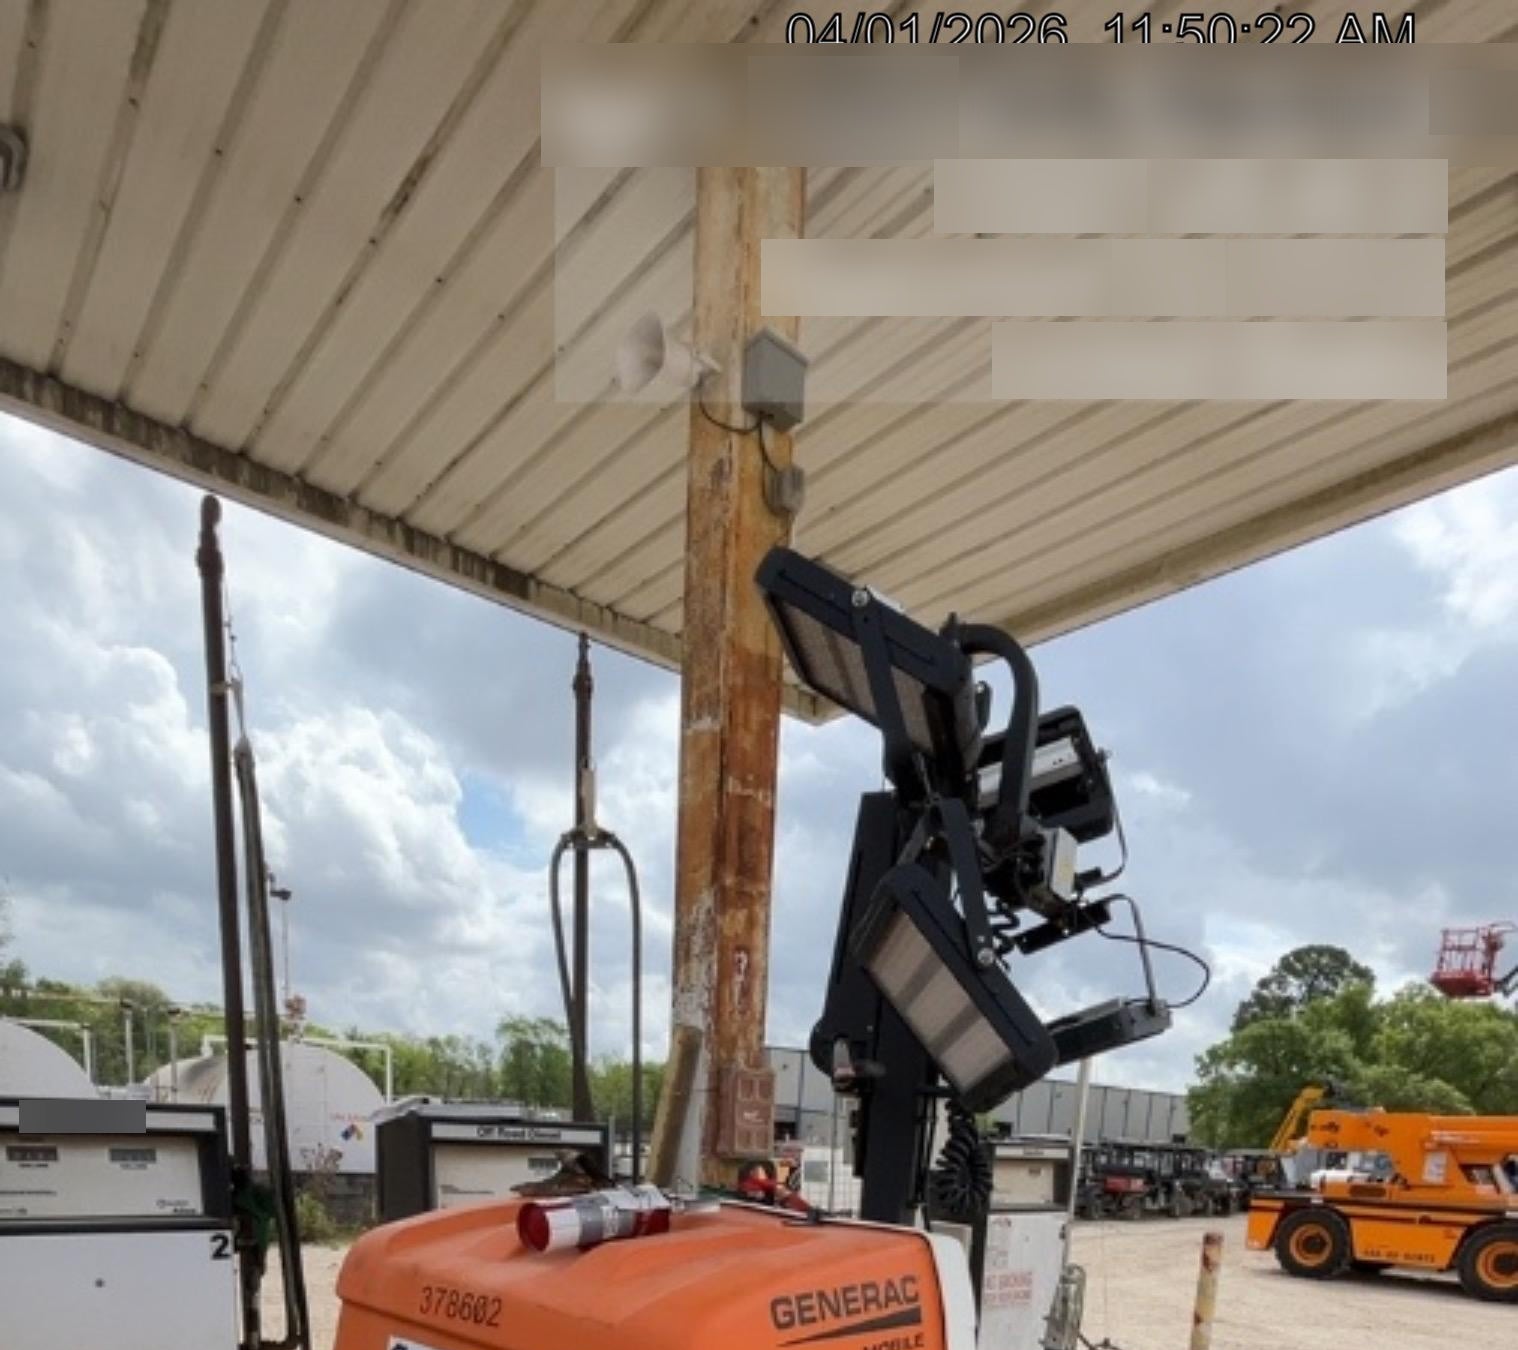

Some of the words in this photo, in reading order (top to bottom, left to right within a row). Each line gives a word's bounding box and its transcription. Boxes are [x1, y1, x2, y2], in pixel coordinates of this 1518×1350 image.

[210, 1232, 231, 1259] 2
[419, 1286, 502, 1327] 378602
[770, 1275, 919, 1330] GENERAC
